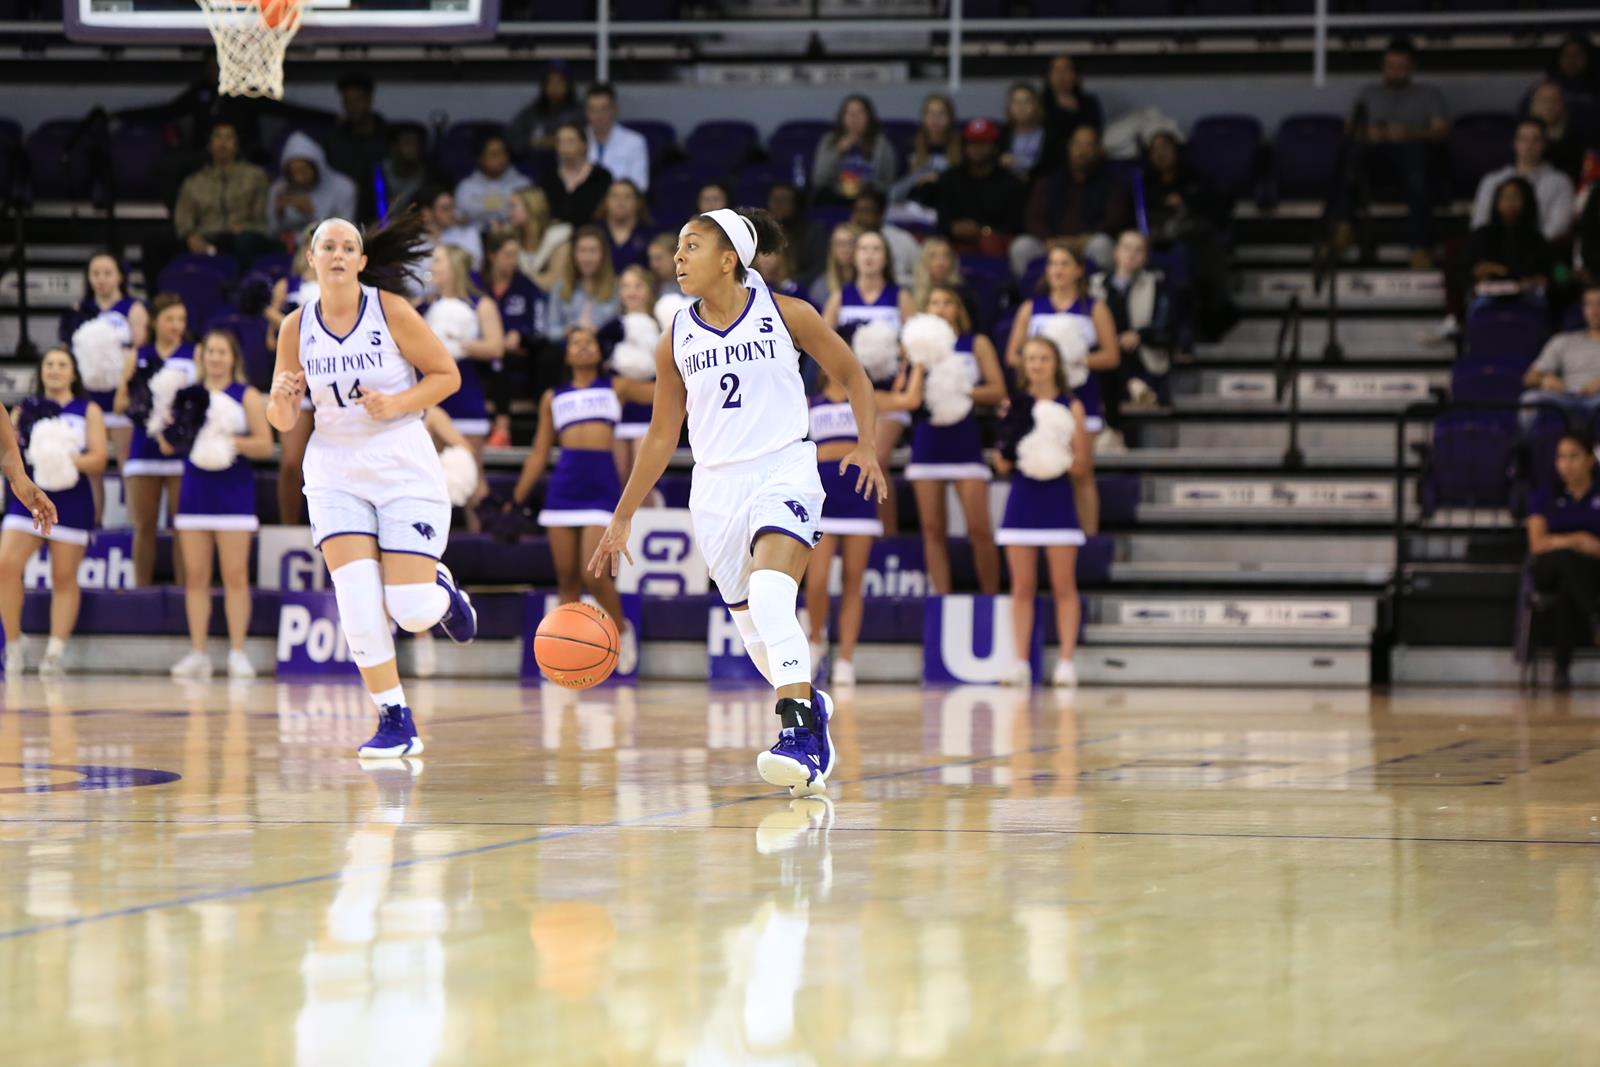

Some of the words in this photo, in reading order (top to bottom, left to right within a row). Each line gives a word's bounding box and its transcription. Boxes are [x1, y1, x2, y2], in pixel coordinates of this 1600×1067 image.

[306, 356, 337, 377] HIGH
[341, 351, 384, 372] POINT
[684, 348, 719, 377] HIGH
[724, 339, 777, 365] POINT
[327, 378, 364, 408] 14
[719, 372, 742, 409] 2
[23, 546, 137, 590] Hgh
